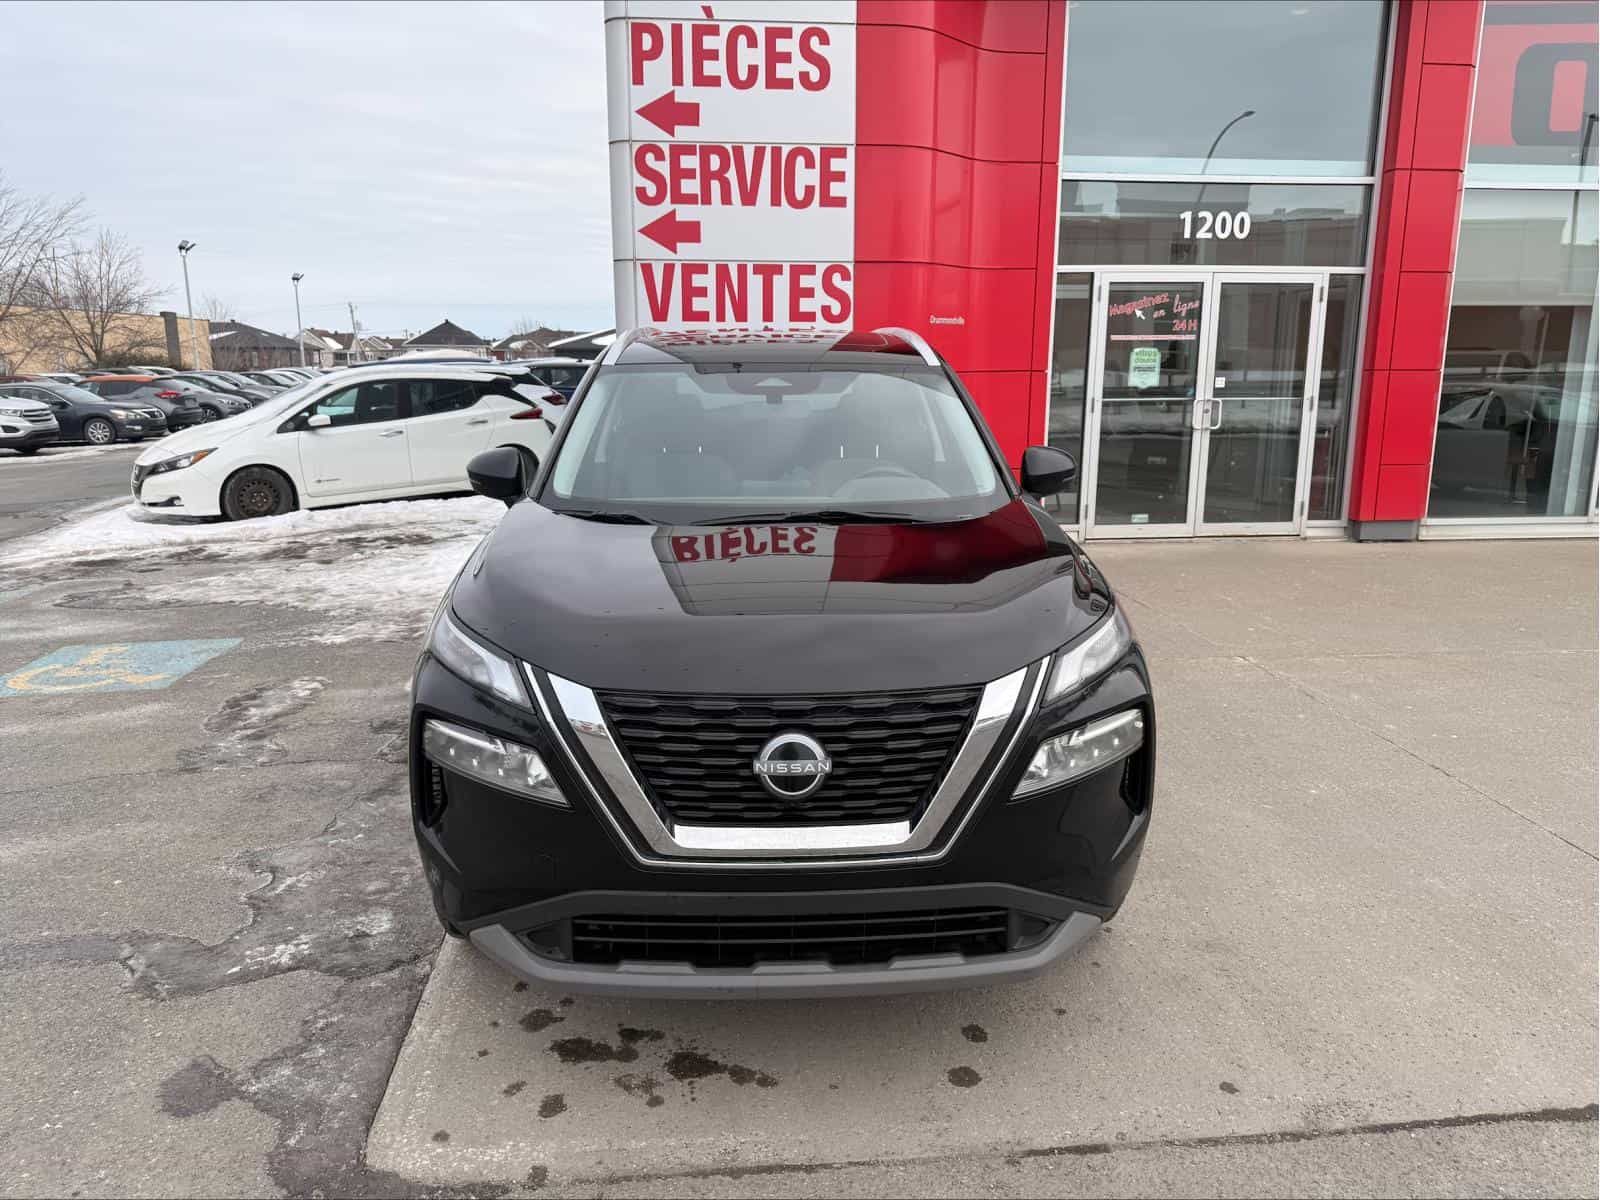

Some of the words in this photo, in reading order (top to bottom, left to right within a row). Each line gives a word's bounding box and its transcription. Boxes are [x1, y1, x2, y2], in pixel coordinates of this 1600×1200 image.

[630, 5, 832, 92] PIÈCES
[634, 143, 848, 210] SERVICE
[1179, 210, 1251, 240] 1200
[639, 262, 852, 324] VENTES
[755, 762, 830, 773] NISSAN
